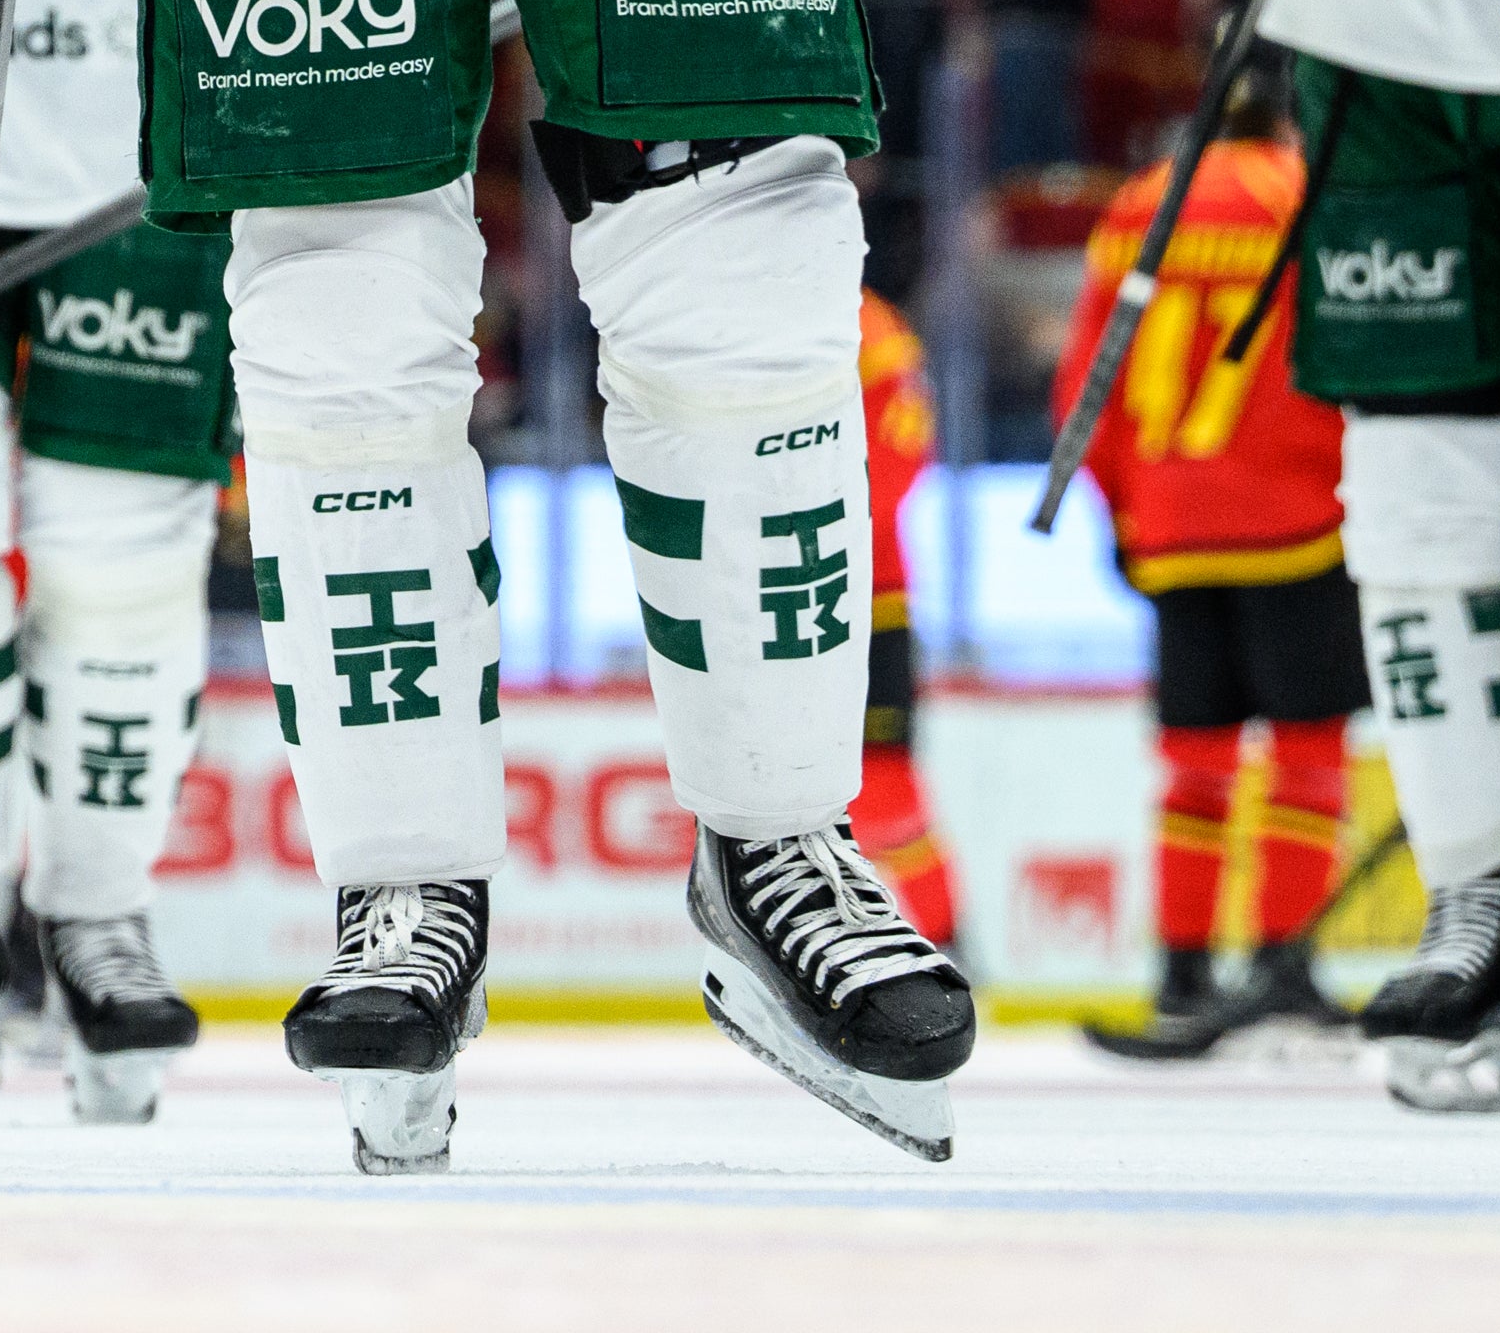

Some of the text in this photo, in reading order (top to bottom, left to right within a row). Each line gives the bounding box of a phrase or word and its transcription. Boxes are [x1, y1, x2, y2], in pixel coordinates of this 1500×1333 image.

[197, 56, 435, 90] Brand merch made easy
[754, 420, 841, 457] CCM
[311, 486, 413, 514] CCM
